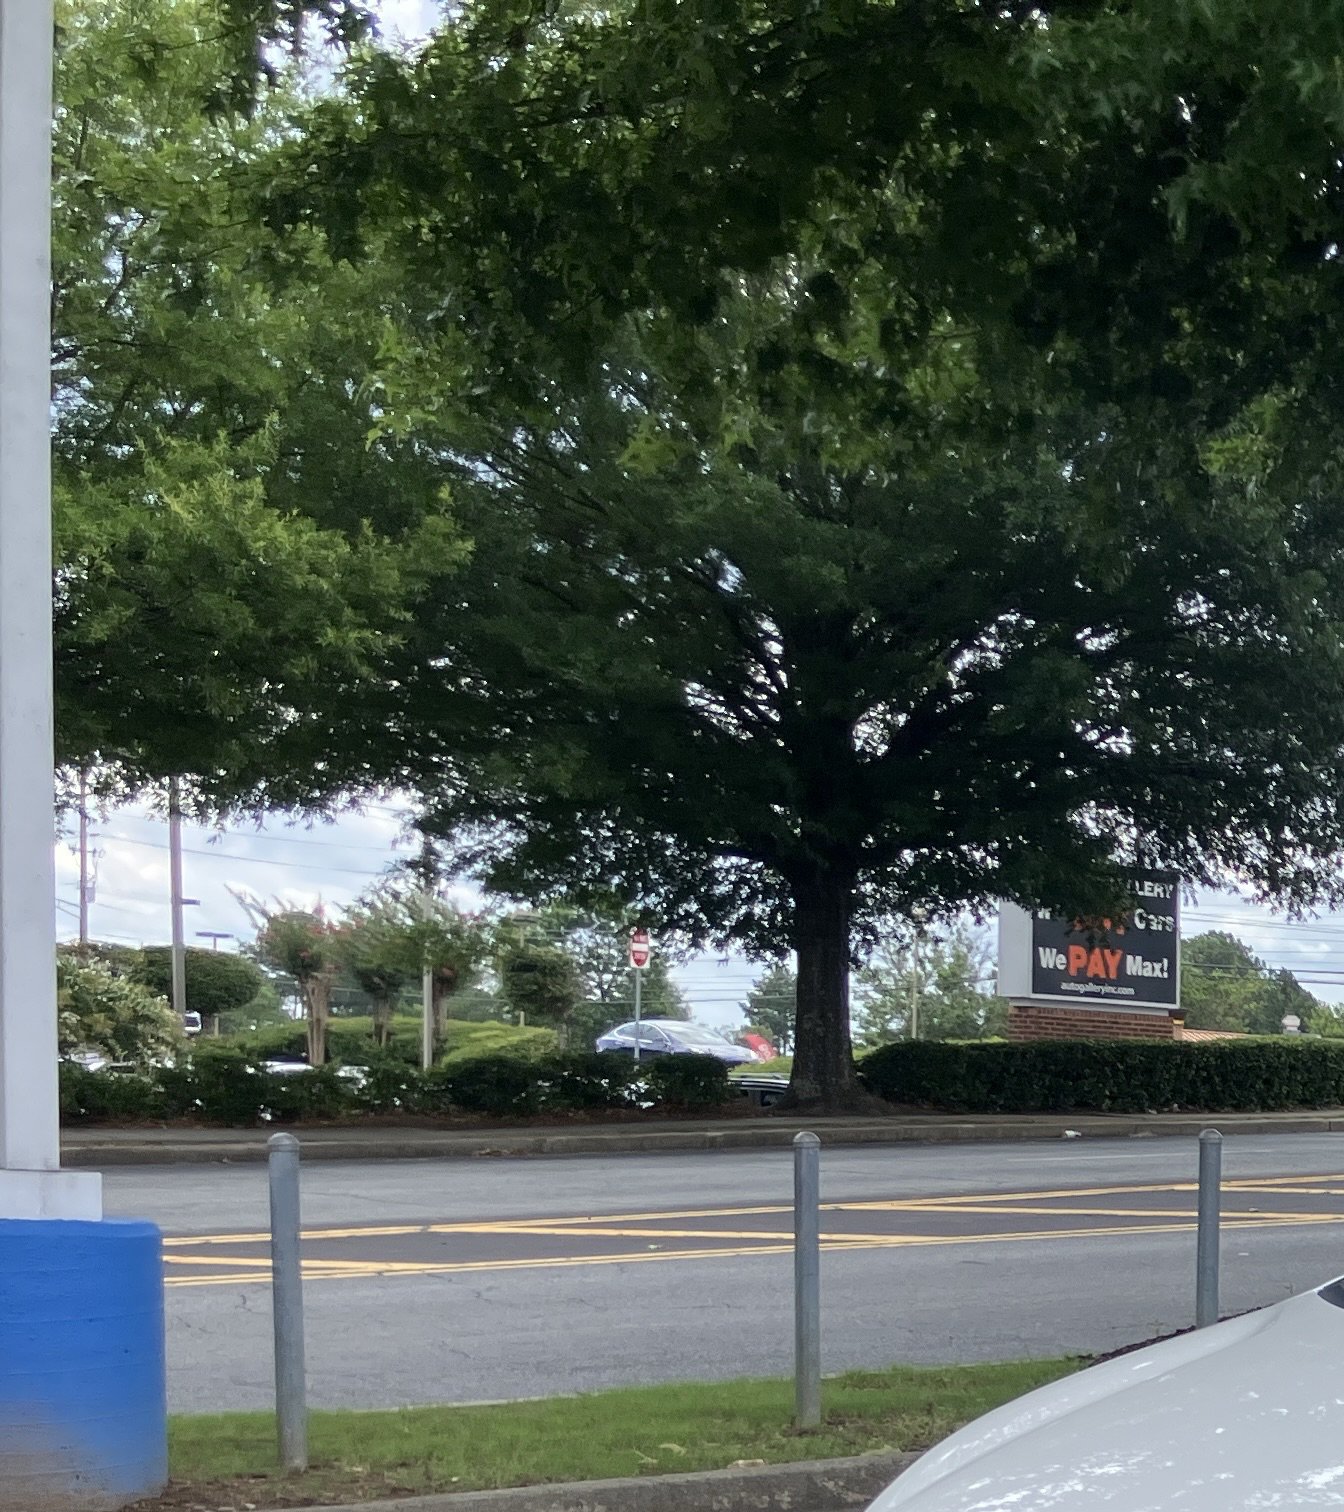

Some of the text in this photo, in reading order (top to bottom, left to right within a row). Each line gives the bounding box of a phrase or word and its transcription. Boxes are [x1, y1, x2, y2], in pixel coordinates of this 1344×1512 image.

[1038, 944, 1169, 980] We PAY Max!
